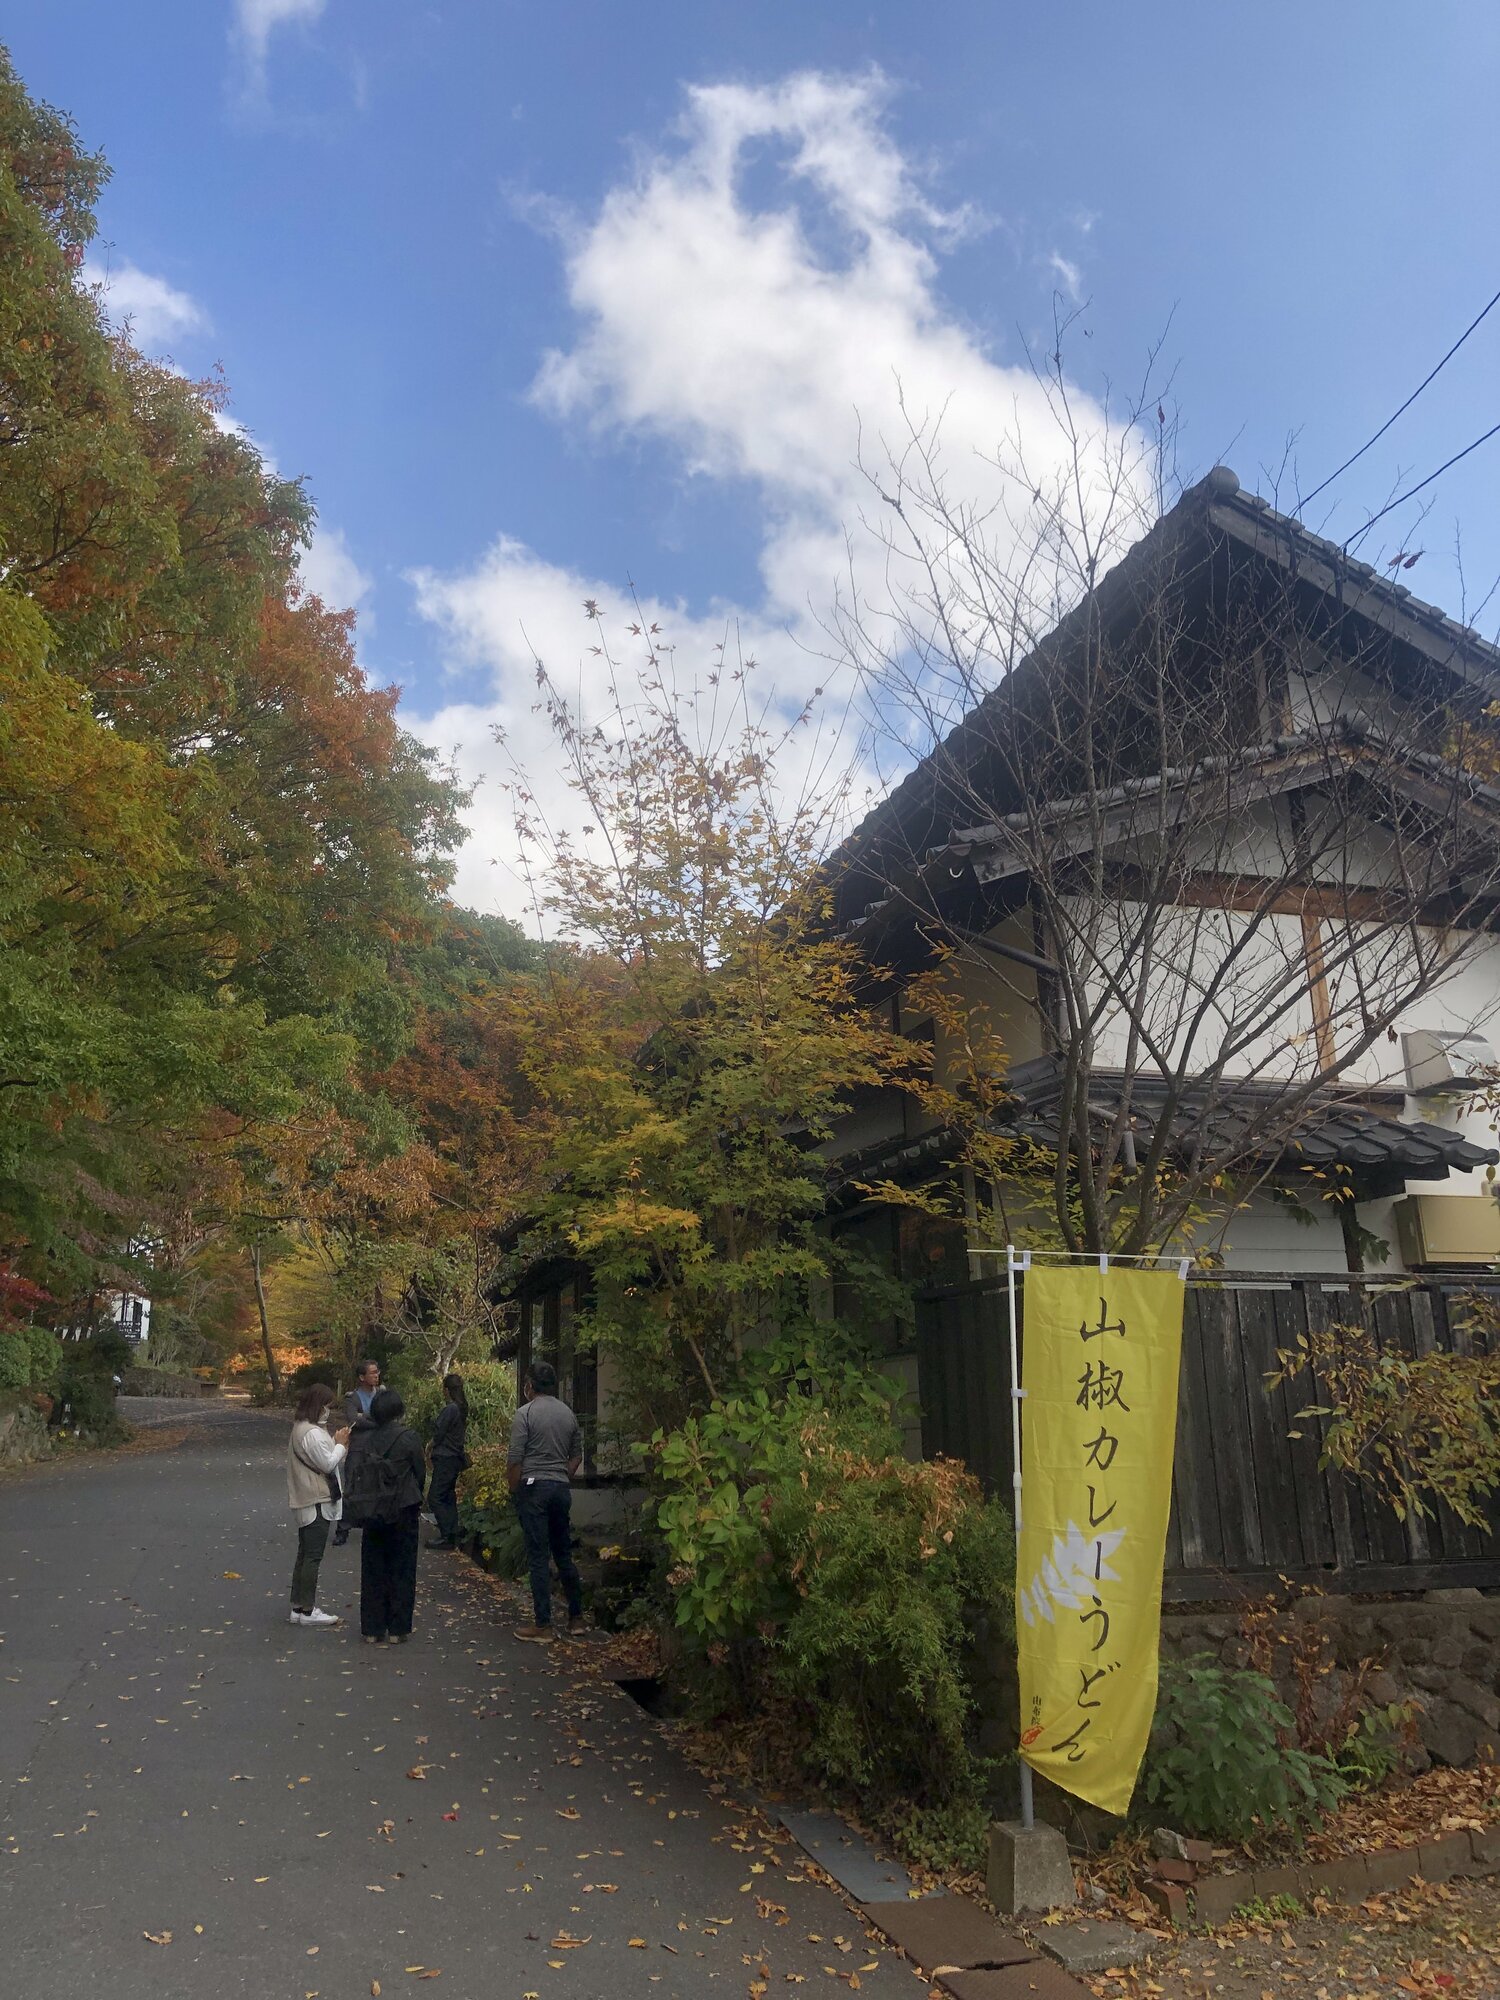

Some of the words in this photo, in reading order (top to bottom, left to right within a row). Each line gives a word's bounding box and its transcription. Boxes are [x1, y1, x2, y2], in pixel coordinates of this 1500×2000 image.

[1051, 1296, 1131, 1763] 山椒カレーうどん
